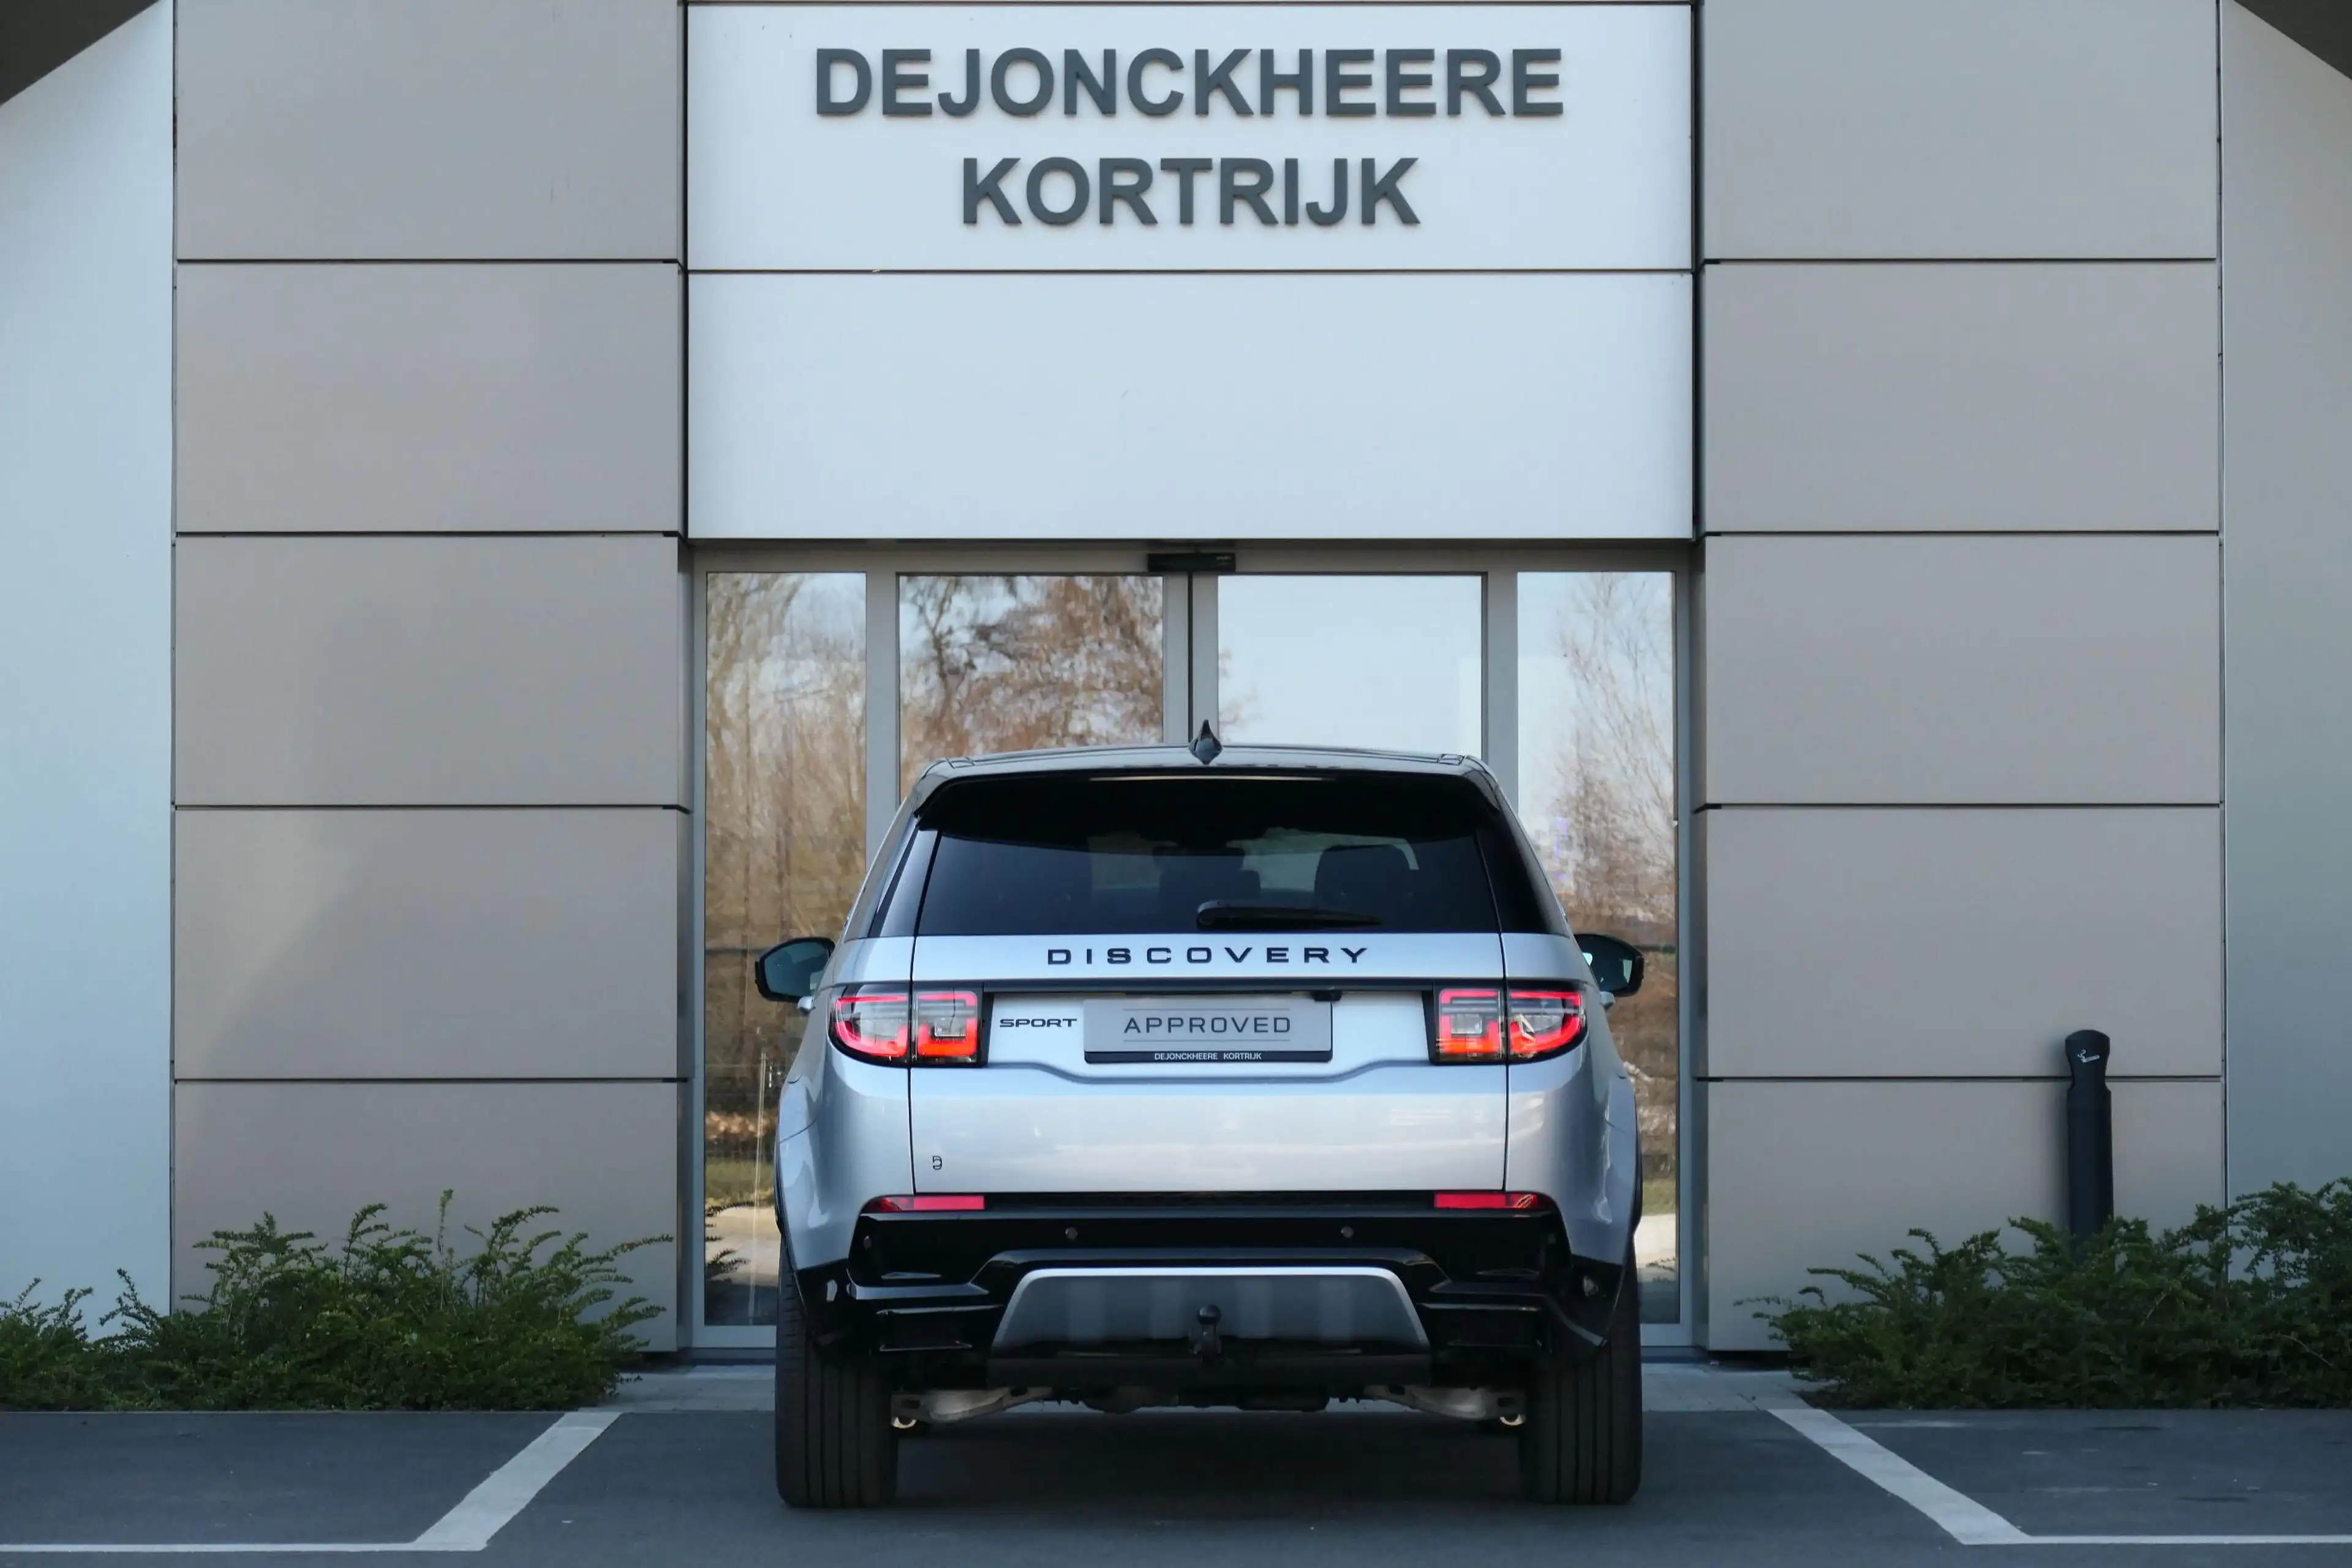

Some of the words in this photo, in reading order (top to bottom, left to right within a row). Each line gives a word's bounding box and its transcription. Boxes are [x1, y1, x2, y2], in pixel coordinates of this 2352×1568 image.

[816, 47, 1564, 118] DEJONCKHEERE
[963, 157, 1420, 227] KORTRIJK
[1047, 947, 1368, 965] DISCOVERY
[999, 1018, 1077, 1028] SPORT
[1123, 1017, 1291, 1033] APPROVED
